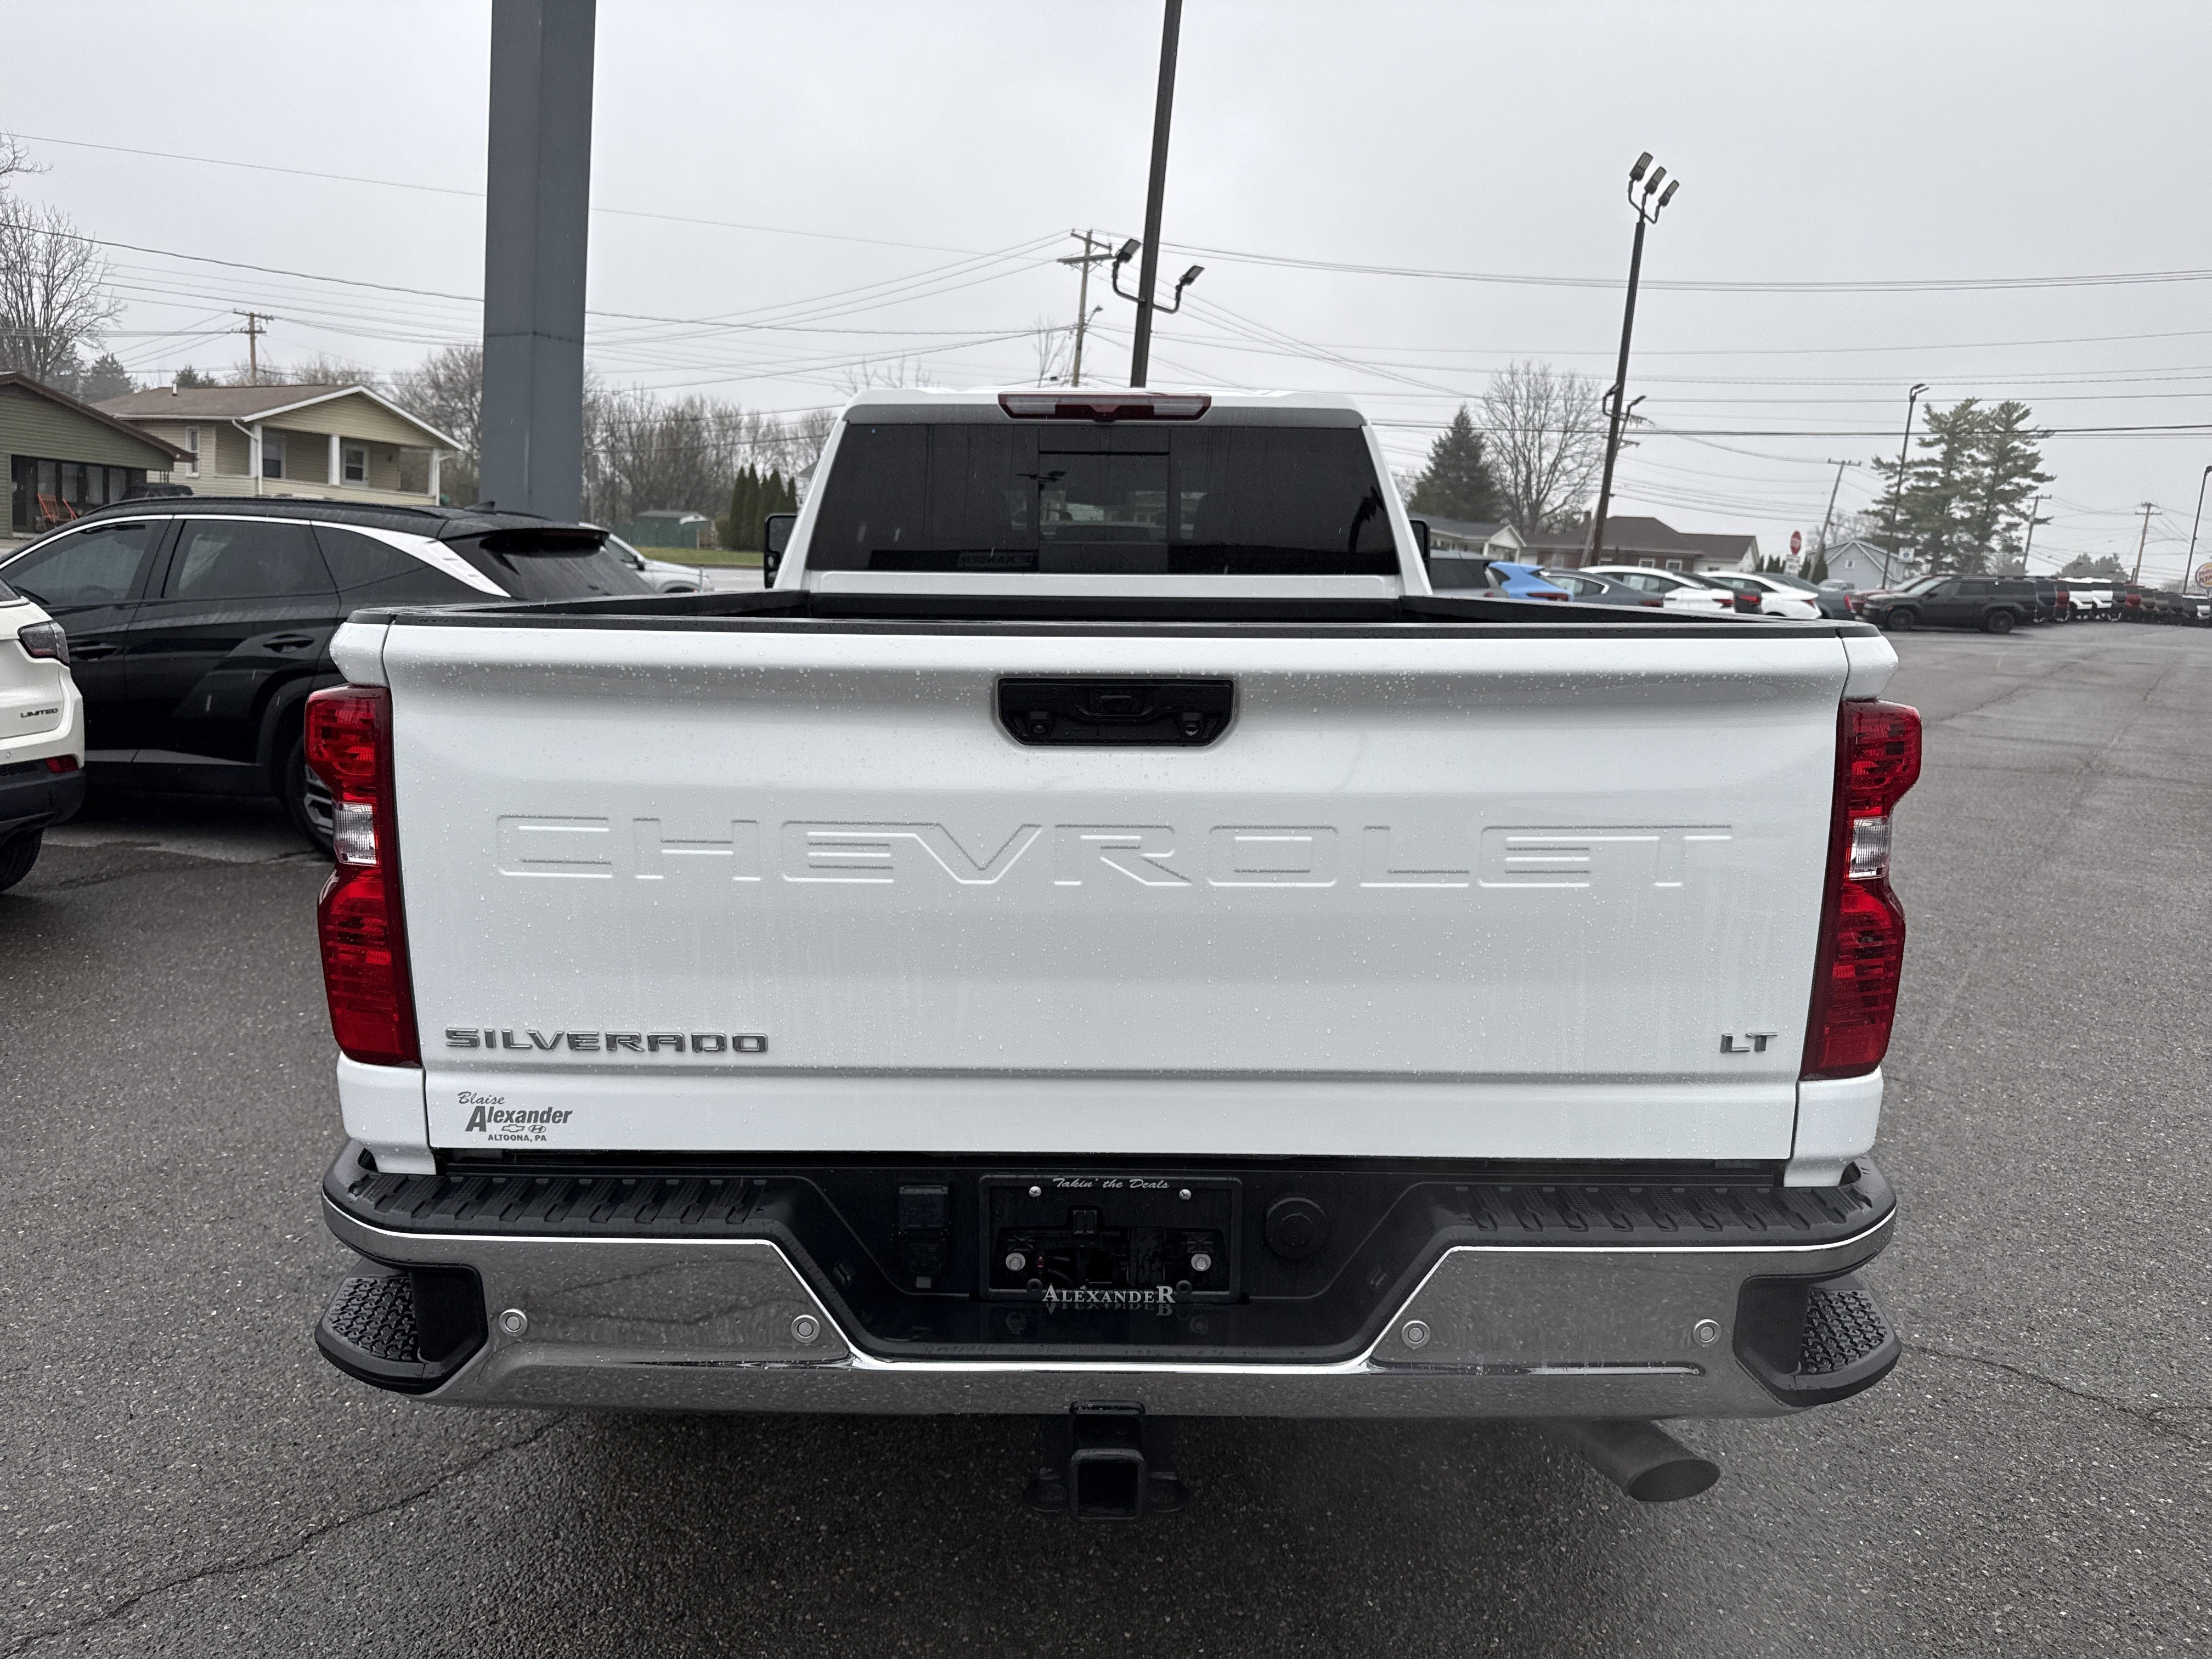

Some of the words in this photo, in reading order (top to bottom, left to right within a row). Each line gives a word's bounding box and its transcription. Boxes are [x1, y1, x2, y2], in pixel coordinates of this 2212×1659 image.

[20, 707, 59, 718] LIMITED
[496, 815, 1733, 888] CHEVROLET
[445, 1027, 768, 1053] SILVERADO
[1719, 1032, 1779, 1053] LT
[457, 1091, 506, 1105] Blaise
[465, 1105, 573, 1132] Alexander
[488, 1134, 533, 1143] ALTOONA,
[1052, 1177, 1098, 1188] Takin'
[1102, 1178, 1124, 1188] the
[1129, 1178, 1170, 1189] Deals
[1042, 1284, 1176, 1304] ALEXANDER
